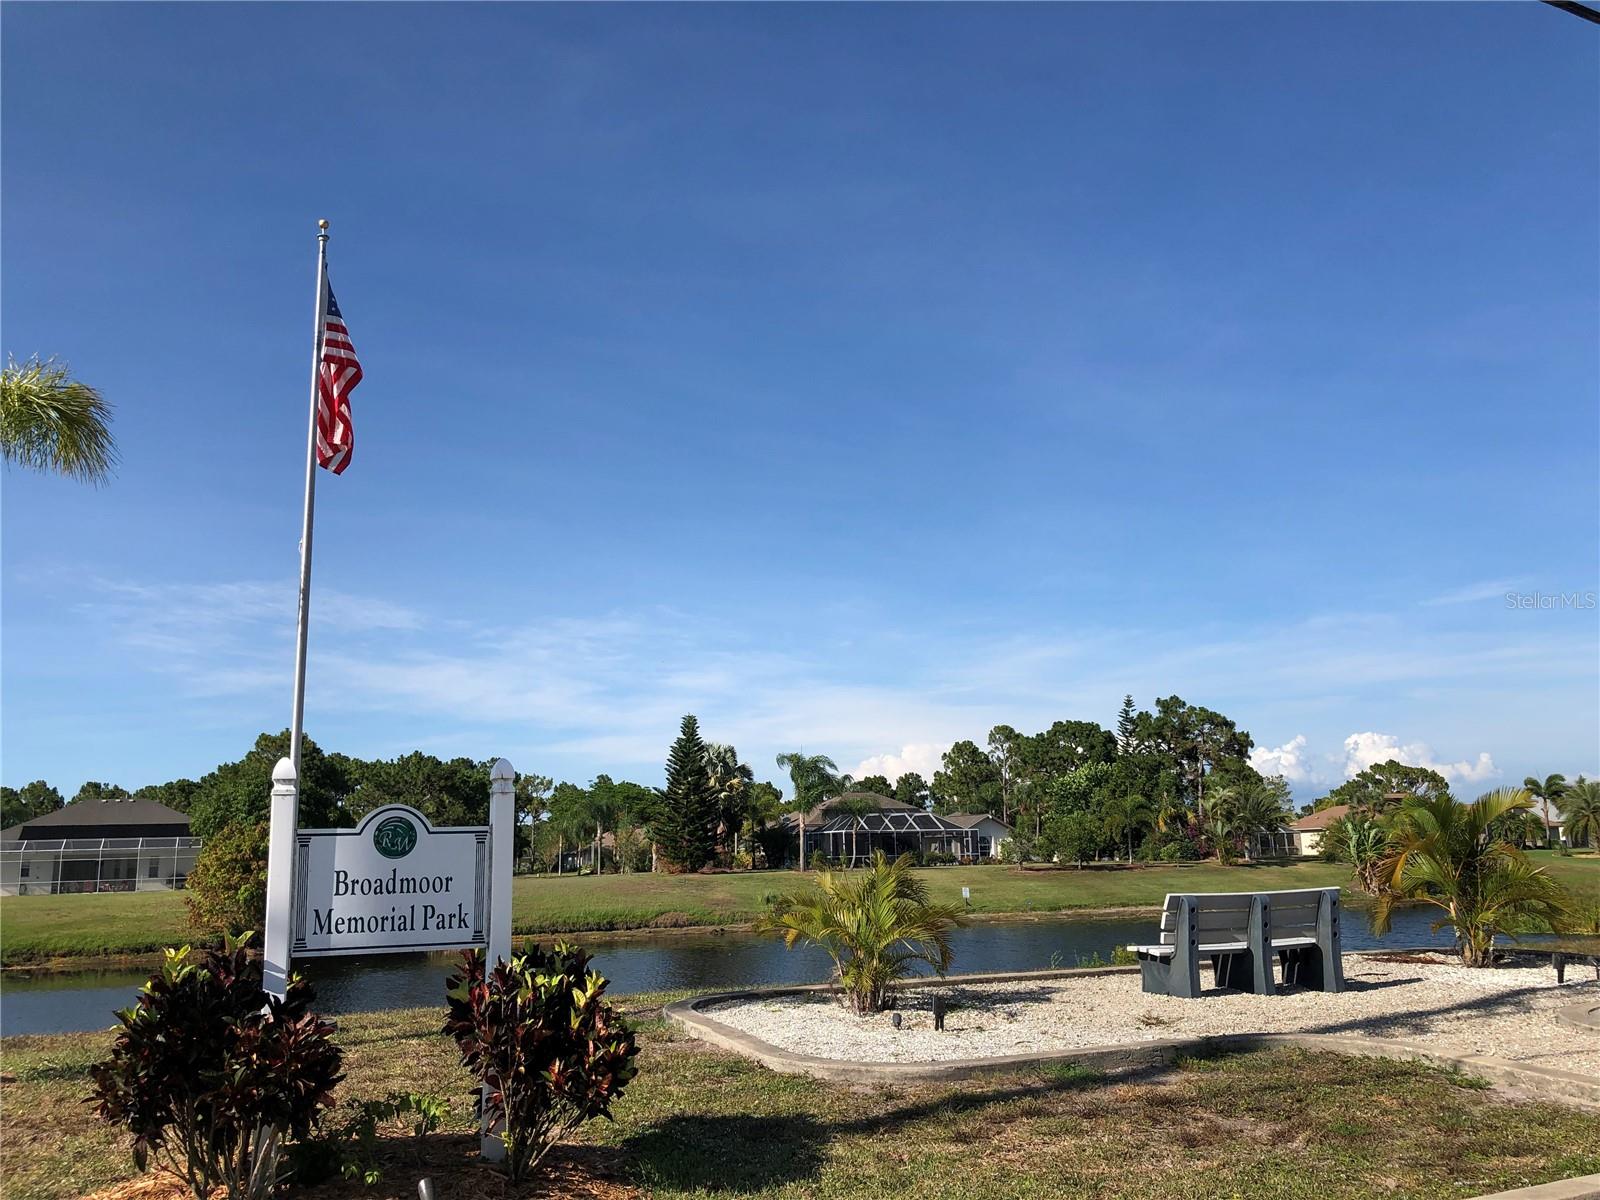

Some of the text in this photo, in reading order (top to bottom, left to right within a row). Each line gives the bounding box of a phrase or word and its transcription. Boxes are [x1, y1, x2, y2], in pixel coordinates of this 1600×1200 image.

[333, 868, 453, 897] Broadmoor
[312, 903, 470, 936] Memorial Park
